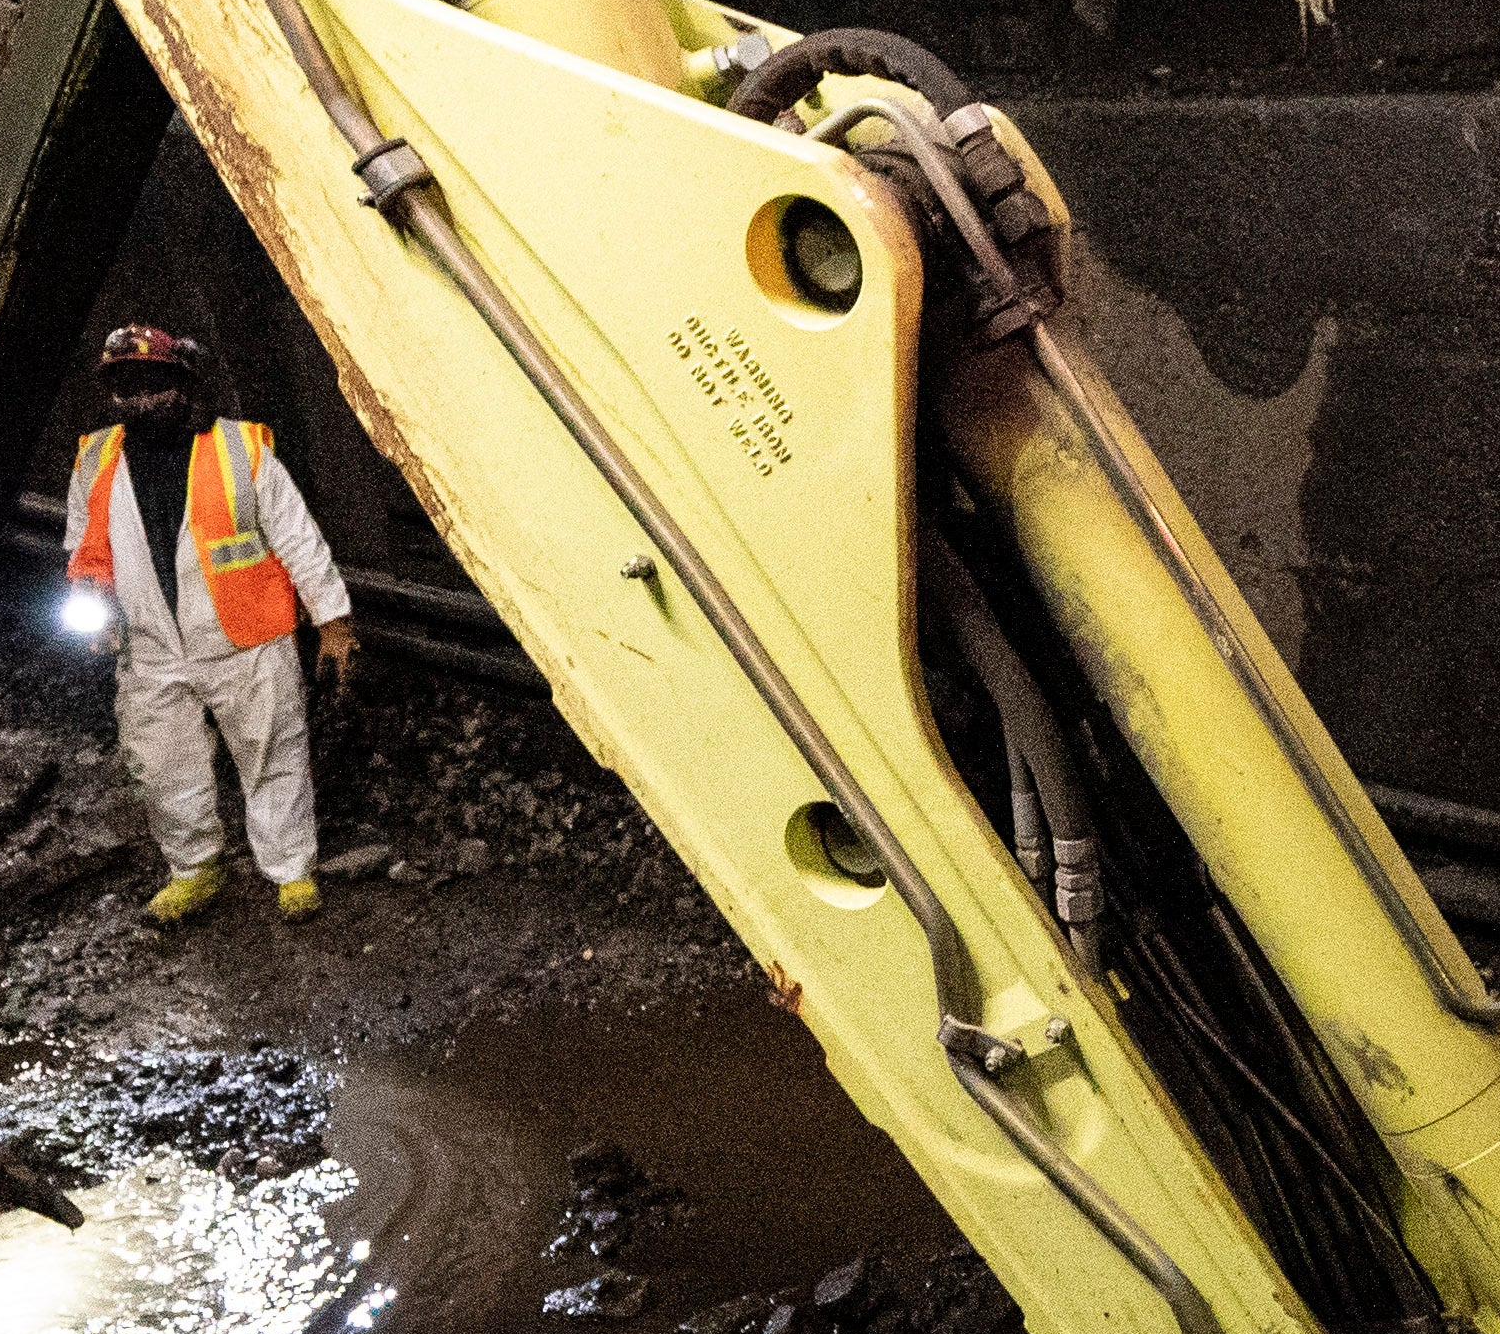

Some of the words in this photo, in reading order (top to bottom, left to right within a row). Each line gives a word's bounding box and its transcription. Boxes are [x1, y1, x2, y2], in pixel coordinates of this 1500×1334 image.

[667, 331, 691, 359] DO
[692, 366, 727, 407] NOT
[729, 420, 772, 476] WELD
[685, 315, 753, 407] DUCTILE
[752, 414, 792, 464] IRON
[725, 327, 793, 424] WARNING
